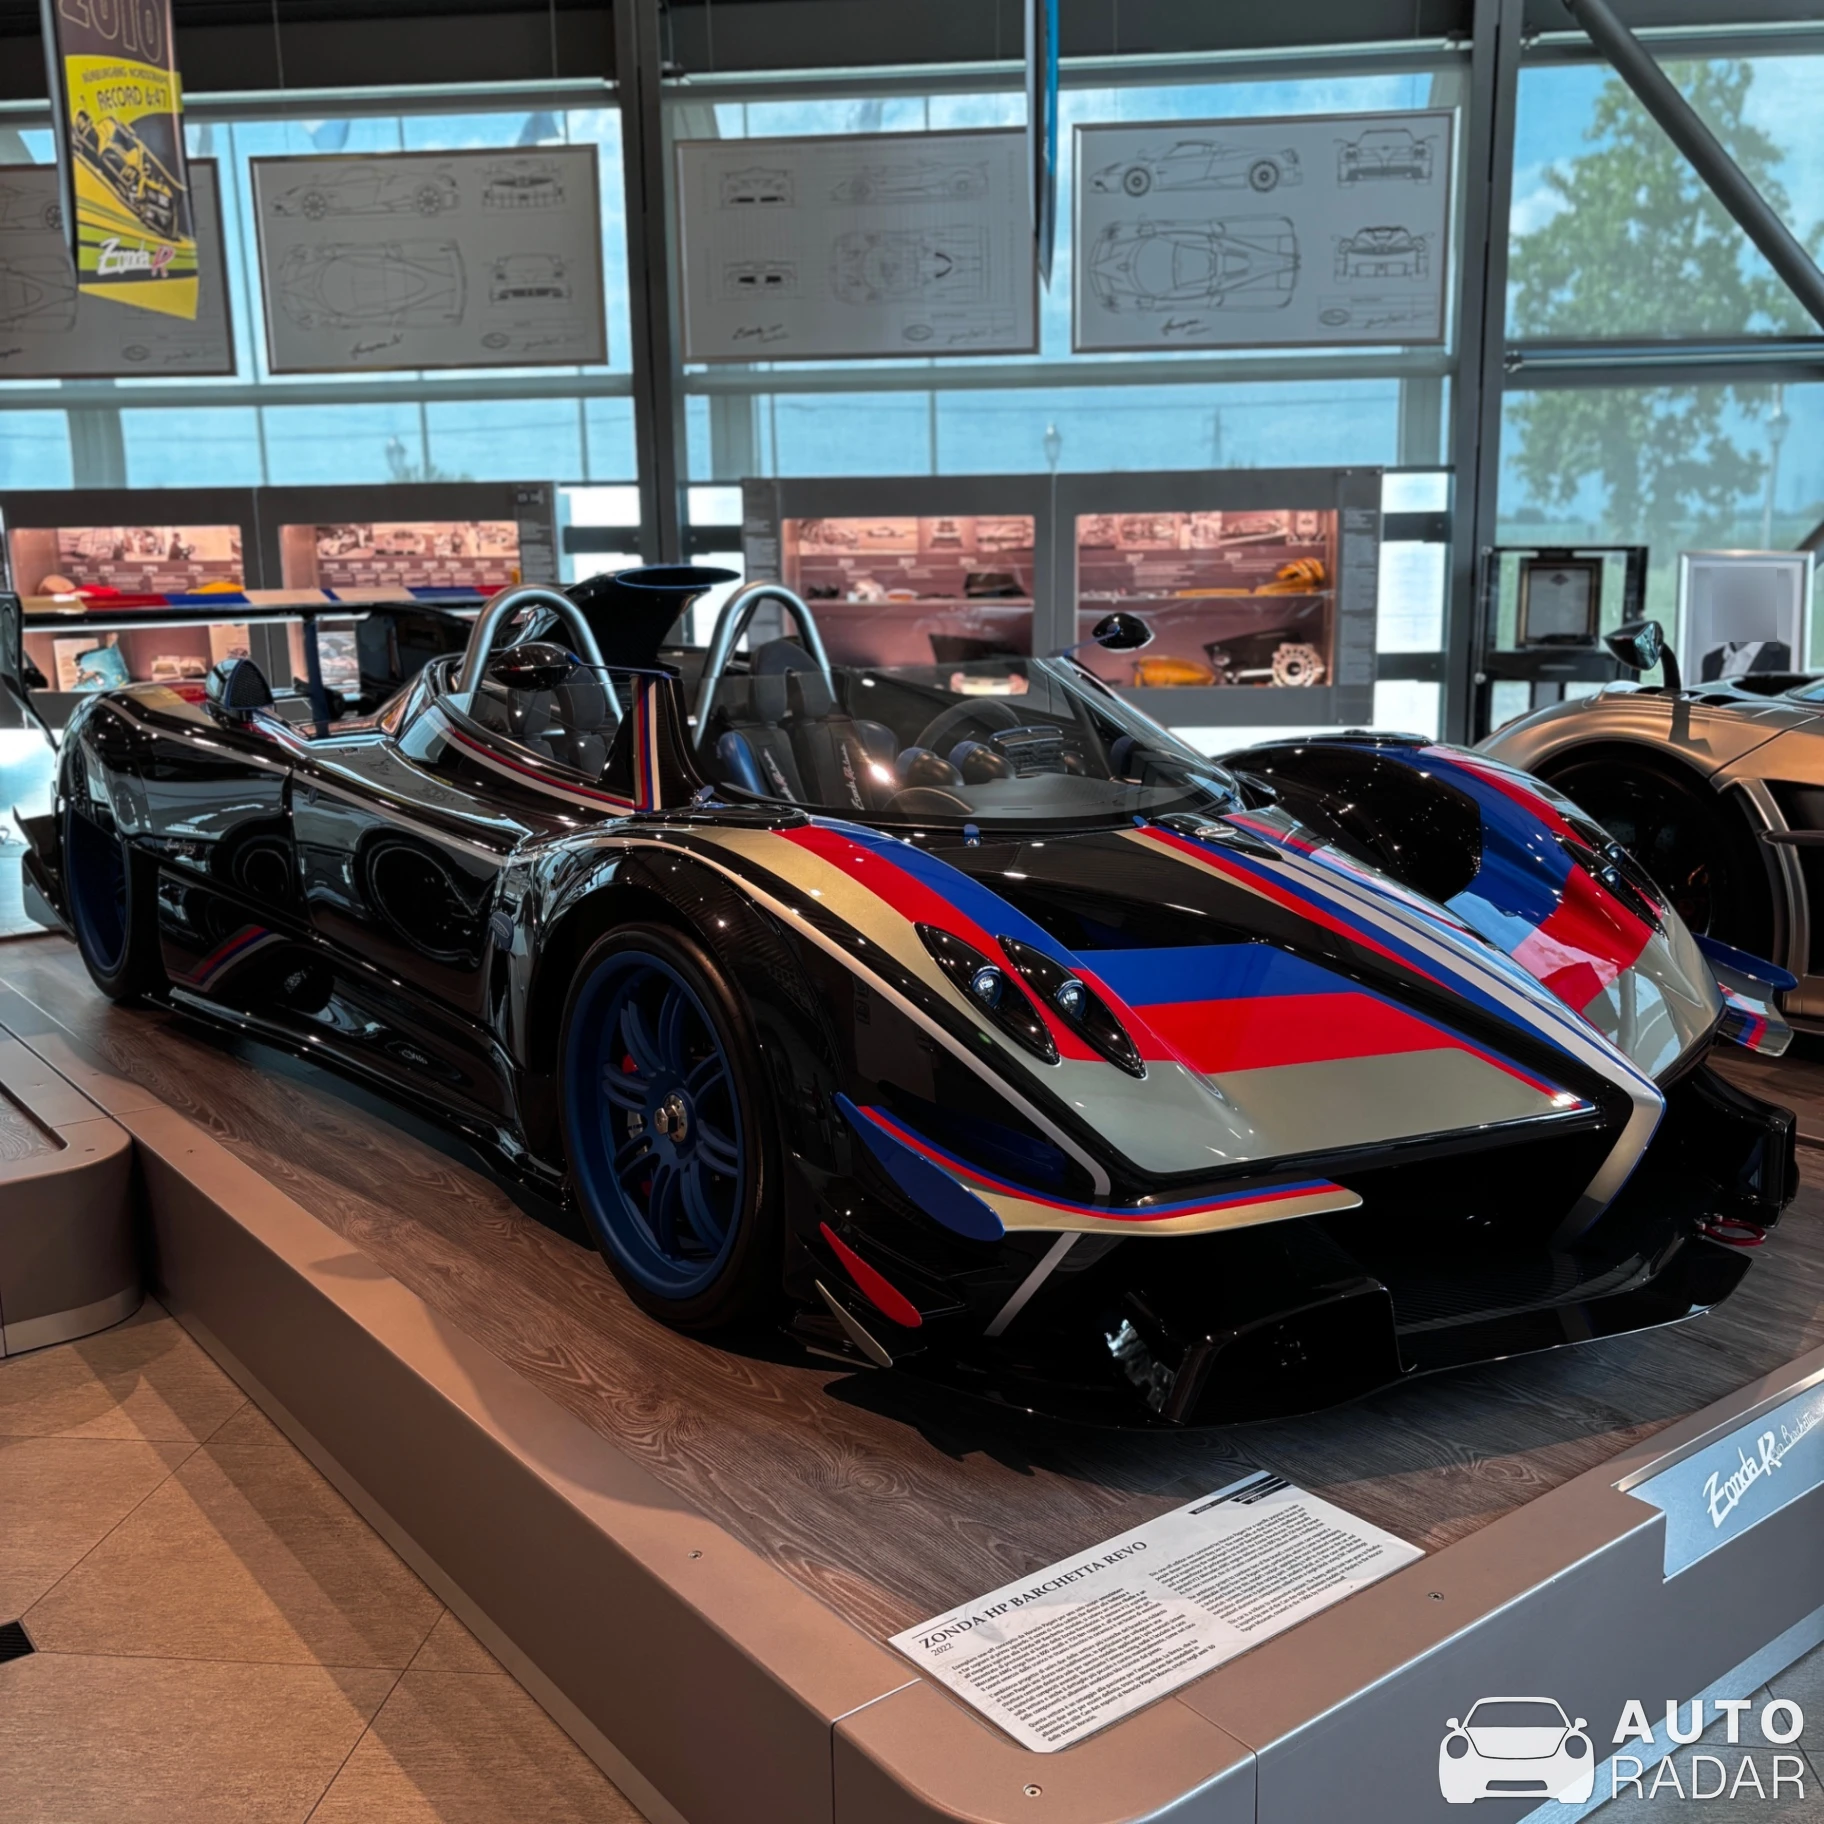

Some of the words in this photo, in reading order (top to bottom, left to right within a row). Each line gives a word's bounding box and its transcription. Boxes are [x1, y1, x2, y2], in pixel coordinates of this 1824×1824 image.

[97, 86, 143, 111] RECORD
[97, 238, 150, 276] Zonda
[150, 246, 175, 278] R
[1702, 1446, 1760, 1528] Zonda
[919, 1616, 986, 1649] ZONDA
[984, 1603, 1009, 1619] HP
[1007, 1561, 1106, 1607] BARCHETTA
[1102, 1540, 1148, 1565] REVO
[931, 1642, 954, 1657] 2022
